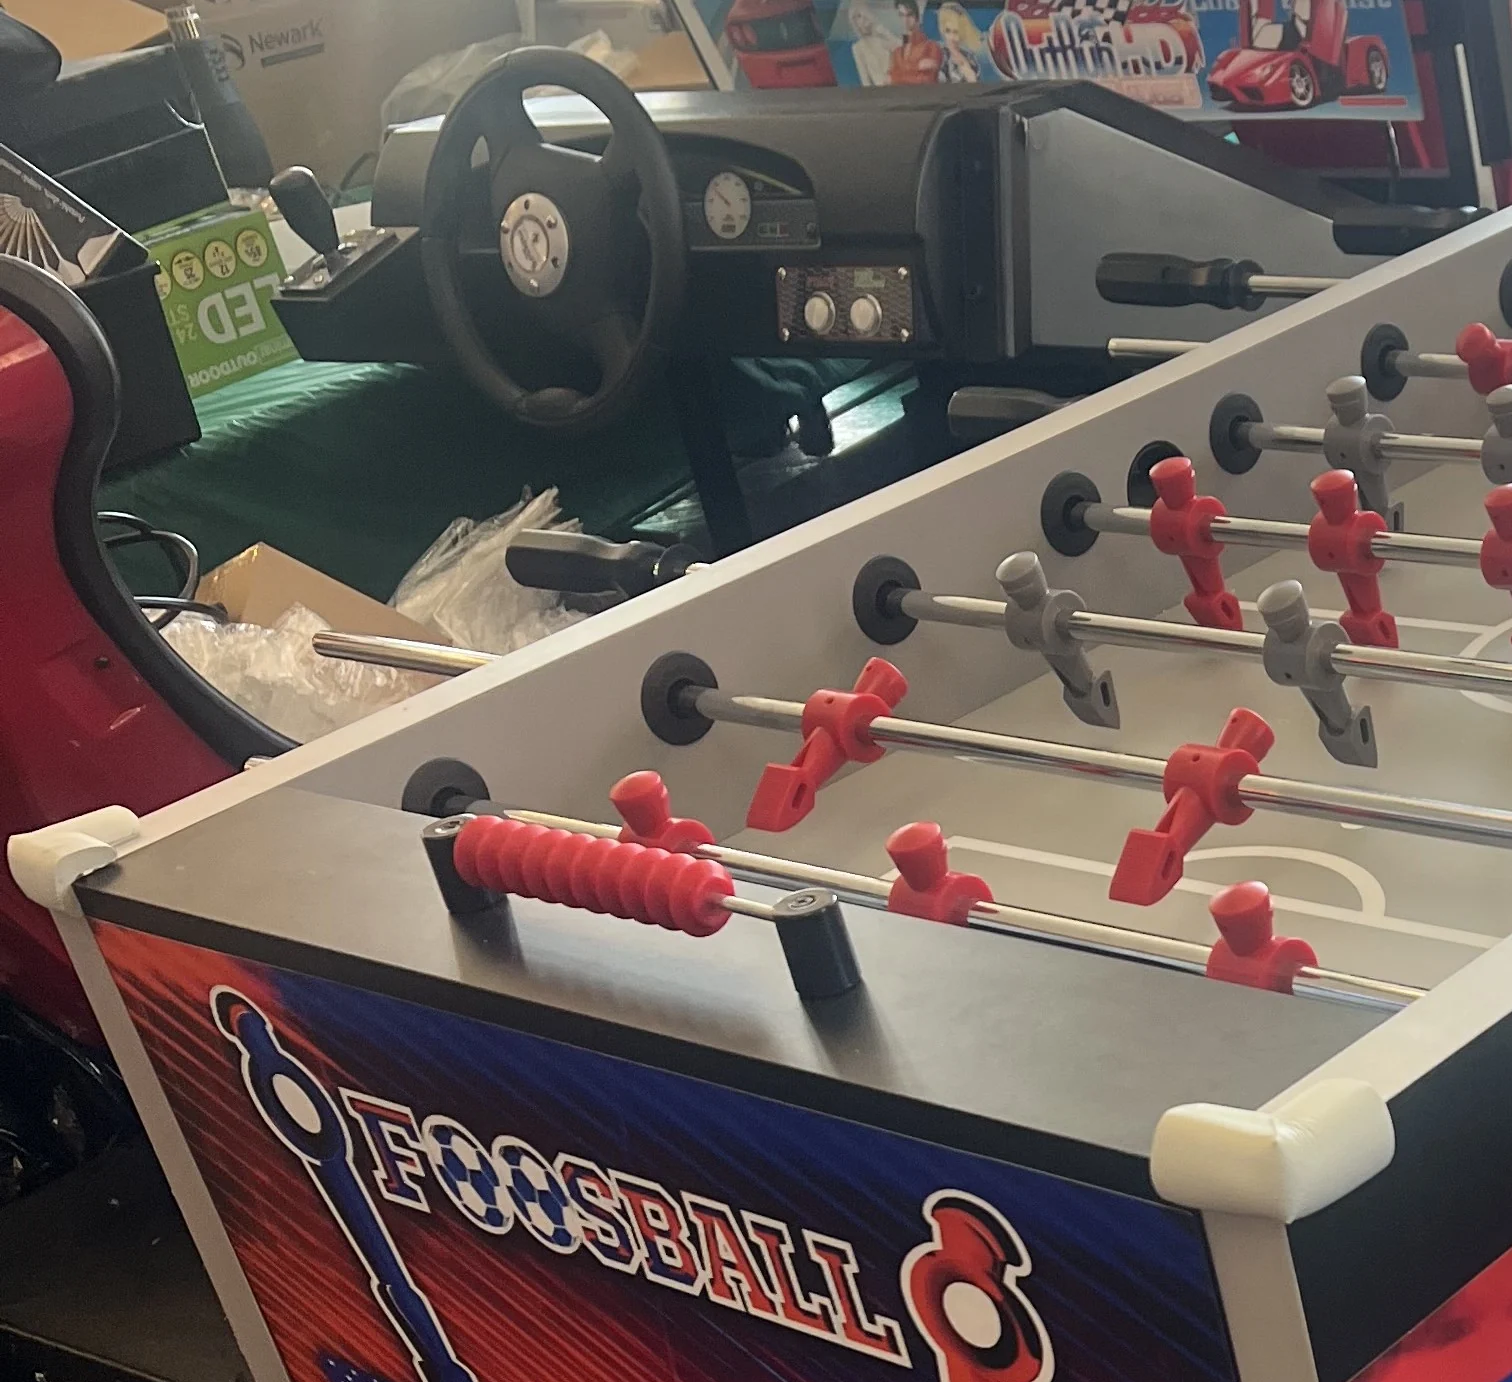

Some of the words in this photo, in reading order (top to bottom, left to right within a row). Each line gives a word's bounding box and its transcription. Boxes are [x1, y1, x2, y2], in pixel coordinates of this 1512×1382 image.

[247, 18, 324, 54] Newark
[187, 350, 258, 389] OUTDOOR
[339, 1086, 912, 1369] FOOSBALL
